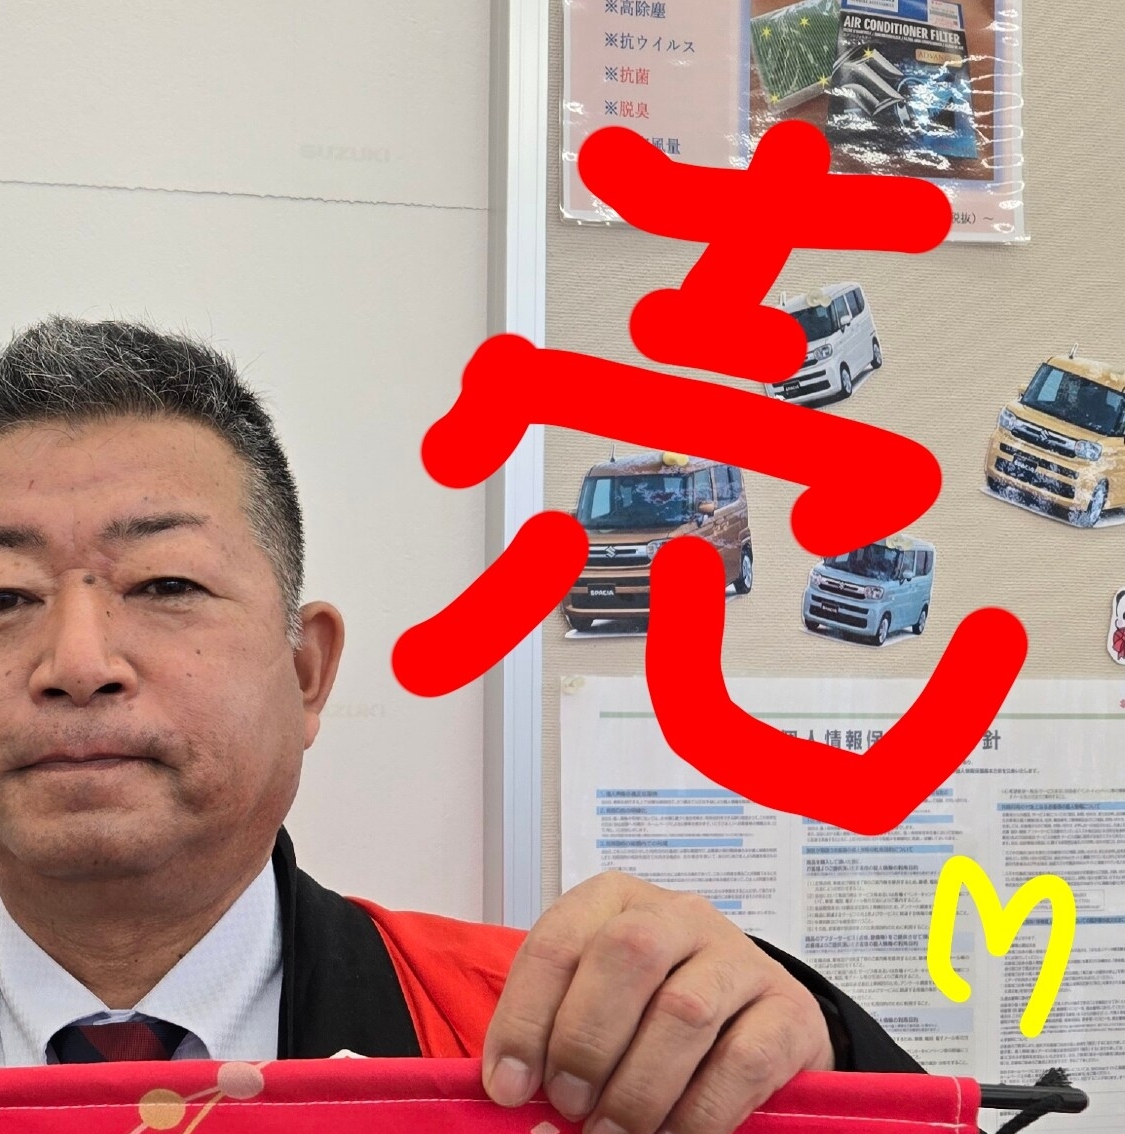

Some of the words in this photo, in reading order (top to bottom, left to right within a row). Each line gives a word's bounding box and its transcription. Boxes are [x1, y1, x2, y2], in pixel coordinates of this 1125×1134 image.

[843, 16, 861, 28] AIR
[863, 18, 928, 39] CONDITIONER
[930, 29, 961, 45] FILTER
[605, 32, 695, 52] ※抗ウイルス
[605, 66, 650, 85] ※抗菌
[605, 100, 650, 118] ※脱臭
[299, 143, 391, 164] SUZUKI
